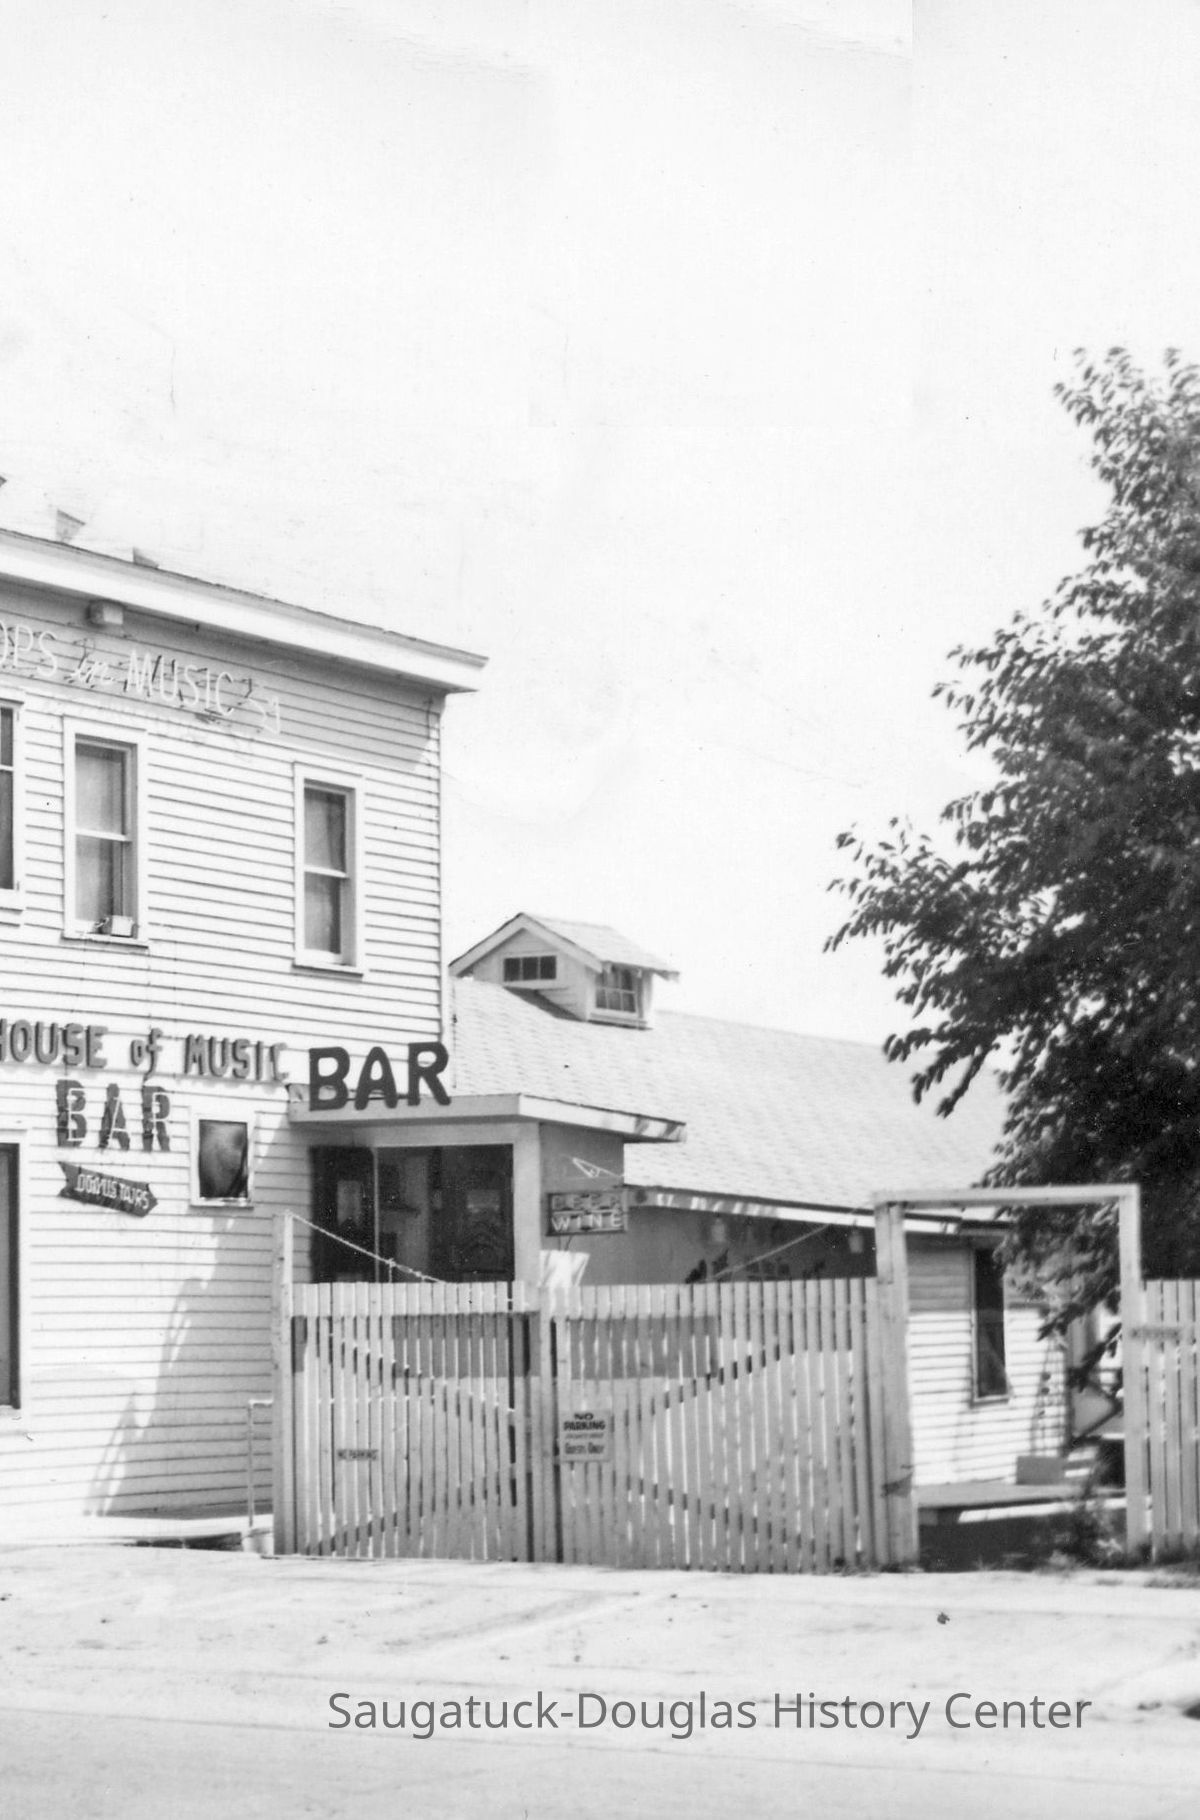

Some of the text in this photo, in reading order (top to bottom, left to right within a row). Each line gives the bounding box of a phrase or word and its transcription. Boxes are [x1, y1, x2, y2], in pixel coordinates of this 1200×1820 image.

[124, 649, 235, 716] MUSIC
[130, 1027, 164, 1075] of
[184, 1033, 292, 1082] MUSIC
[308, 1041, 452, 1112] BAR
[55, 1079, 171, 1153] BAR
[551, 1213, 623, 1232] WINE
[563, 1420, 606, 1431] PARKING
[573, 1412, 594, 1421] NO
